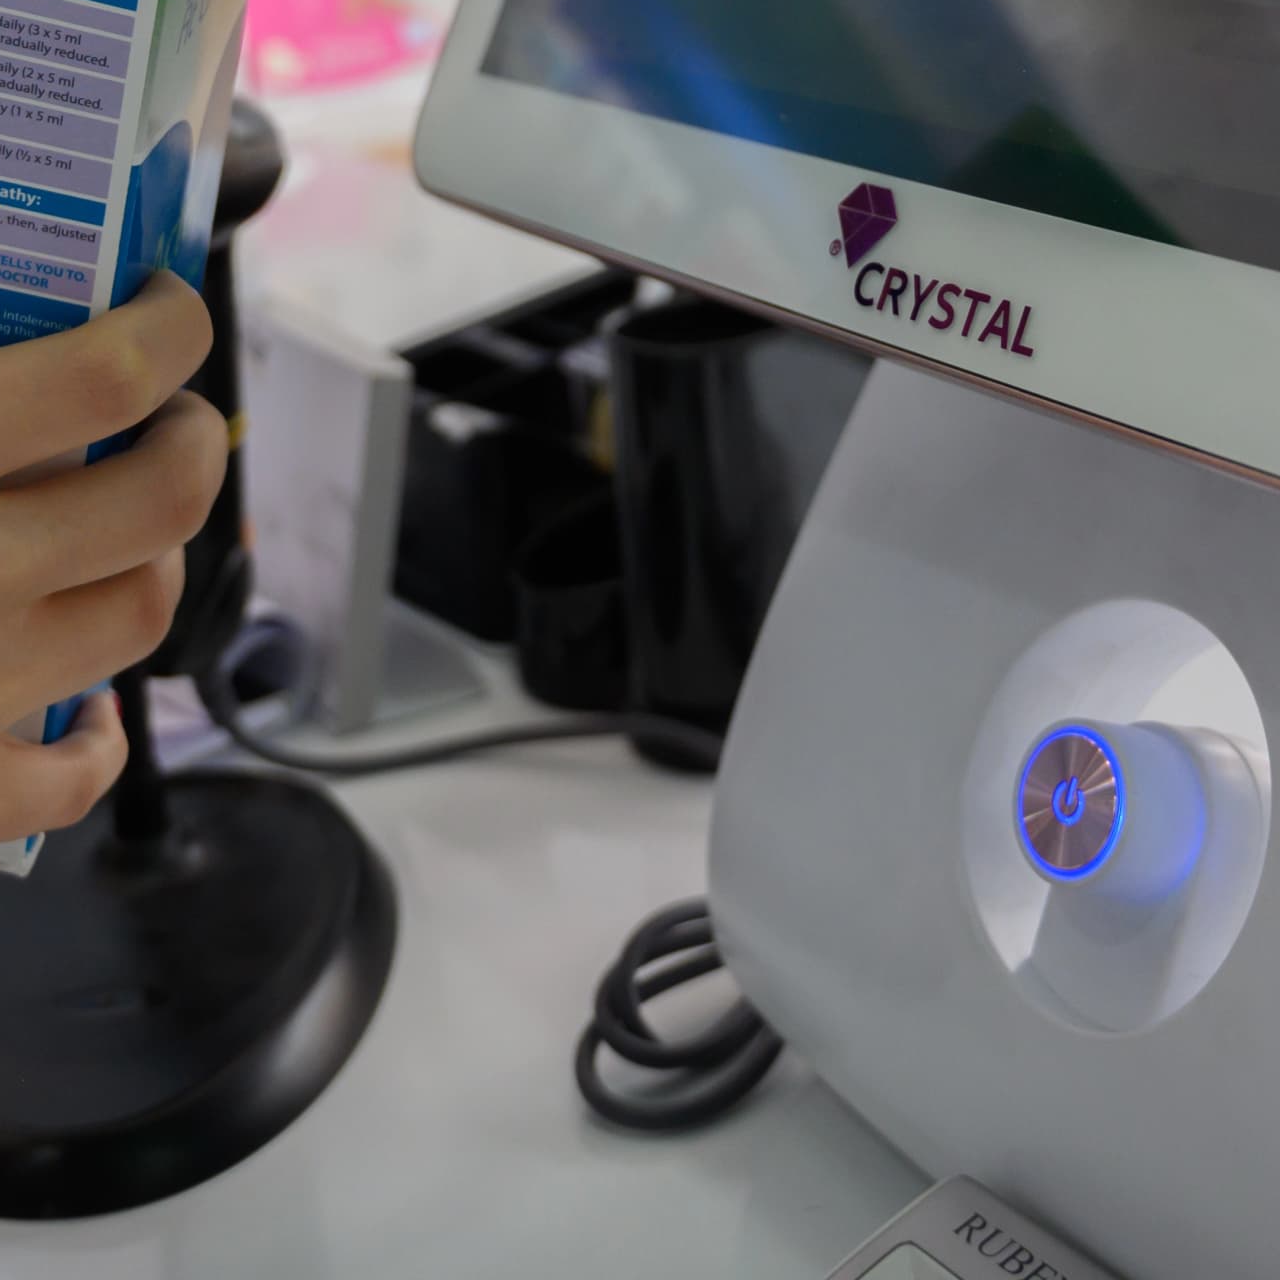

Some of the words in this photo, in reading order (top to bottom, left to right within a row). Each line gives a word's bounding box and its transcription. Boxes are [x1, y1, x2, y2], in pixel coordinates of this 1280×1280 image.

[28, 22, 40, 36] (3
[43, 28, 51, 38] x
[54, 29, 62, 41] 5
[65, 33, 82, 45] ml
[54, 47, 109, 68] reduced.
[22, 65, 34, 80] (2
[37, 71, 45, 81] x
[48, 72, 56, 84] 5
[58, 76, 75, 88] ml
[48, 90, 103, 111] reduced.
[10, 104, 22, 118] (1
[25, 110, 33, 120] x
[36, 110, 44, 122] 5
[47, 115, 64, 127] ml
[7, 213, 38, 232] then,
[42, 222, 97, 243] adjusted
[34, 261, 66, 278] YOU
[66, 268, 87, 283] TO.
[854, 262, 1034, 357] CRYSTAL
[954, 1211, 1068, 1280] RUBE
